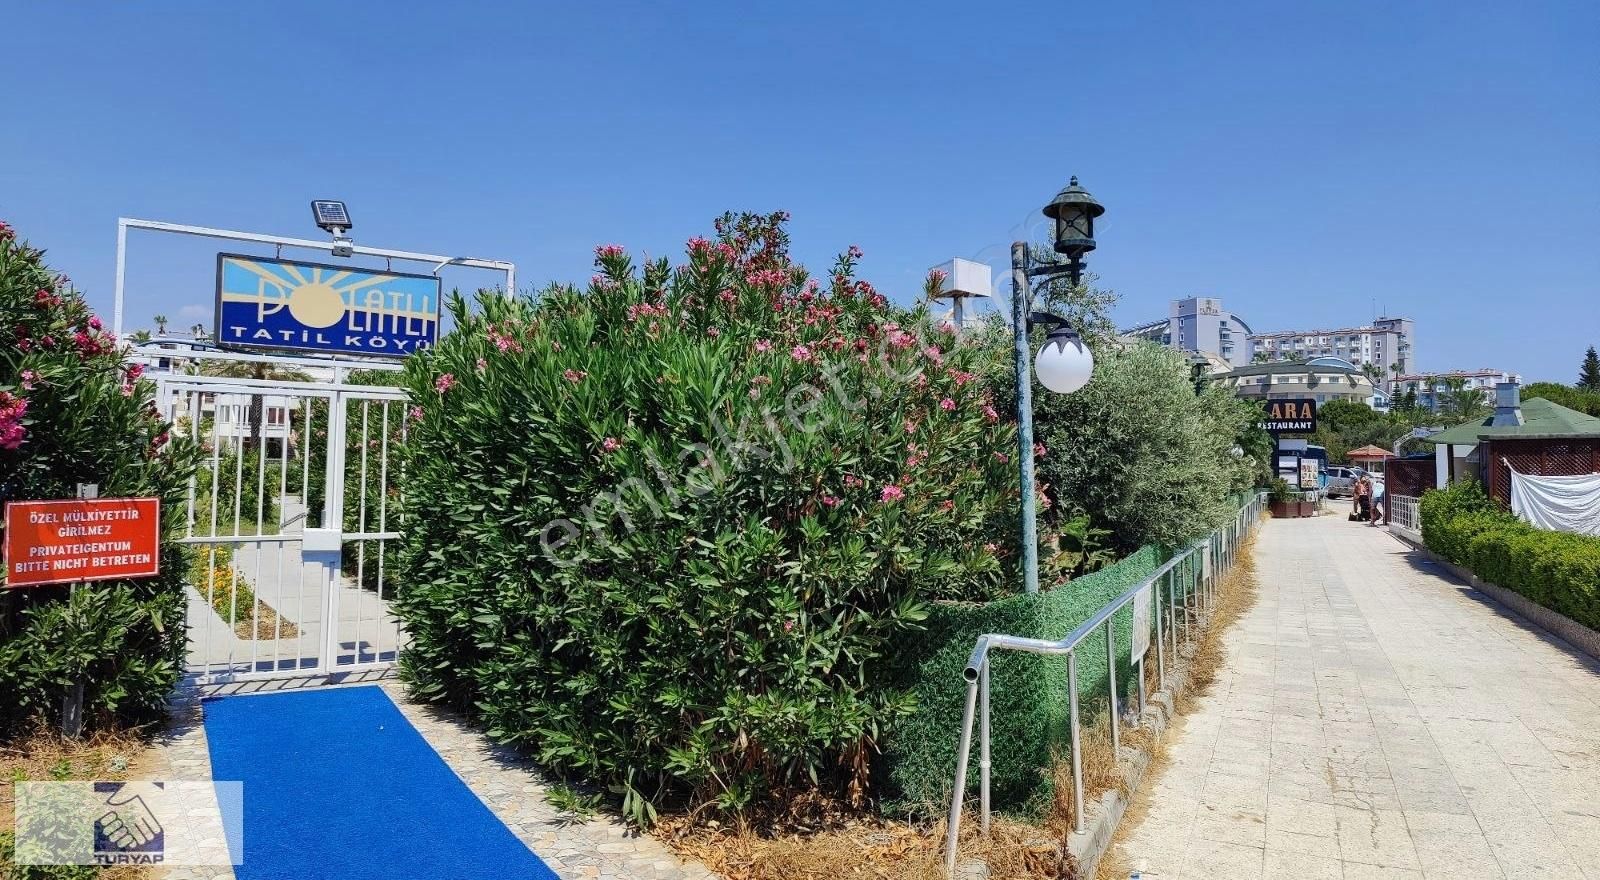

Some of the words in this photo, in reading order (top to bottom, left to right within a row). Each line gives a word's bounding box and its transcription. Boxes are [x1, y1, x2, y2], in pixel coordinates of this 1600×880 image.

[230, 326, 331, 344] TATİL
[345, 335, 430, 351] KÖYÜ
[1271, 402, 1313, 419] ARA
[1257, 421, 1312, 430] RESTAURANT
[30, 511, 59, 524] ÖZEL
[63, 507, 139, 522] MÜLKİYETTİR
[58, 524, 112, 537] GİRİLMEZ
[29, 541, 131, 557] PRIVATEIGENTUM
[15, 560, 49, 573] BITTE
[53, 557, 89, 570] NICHT
[92, 553, 150, 567] BETRETEN
